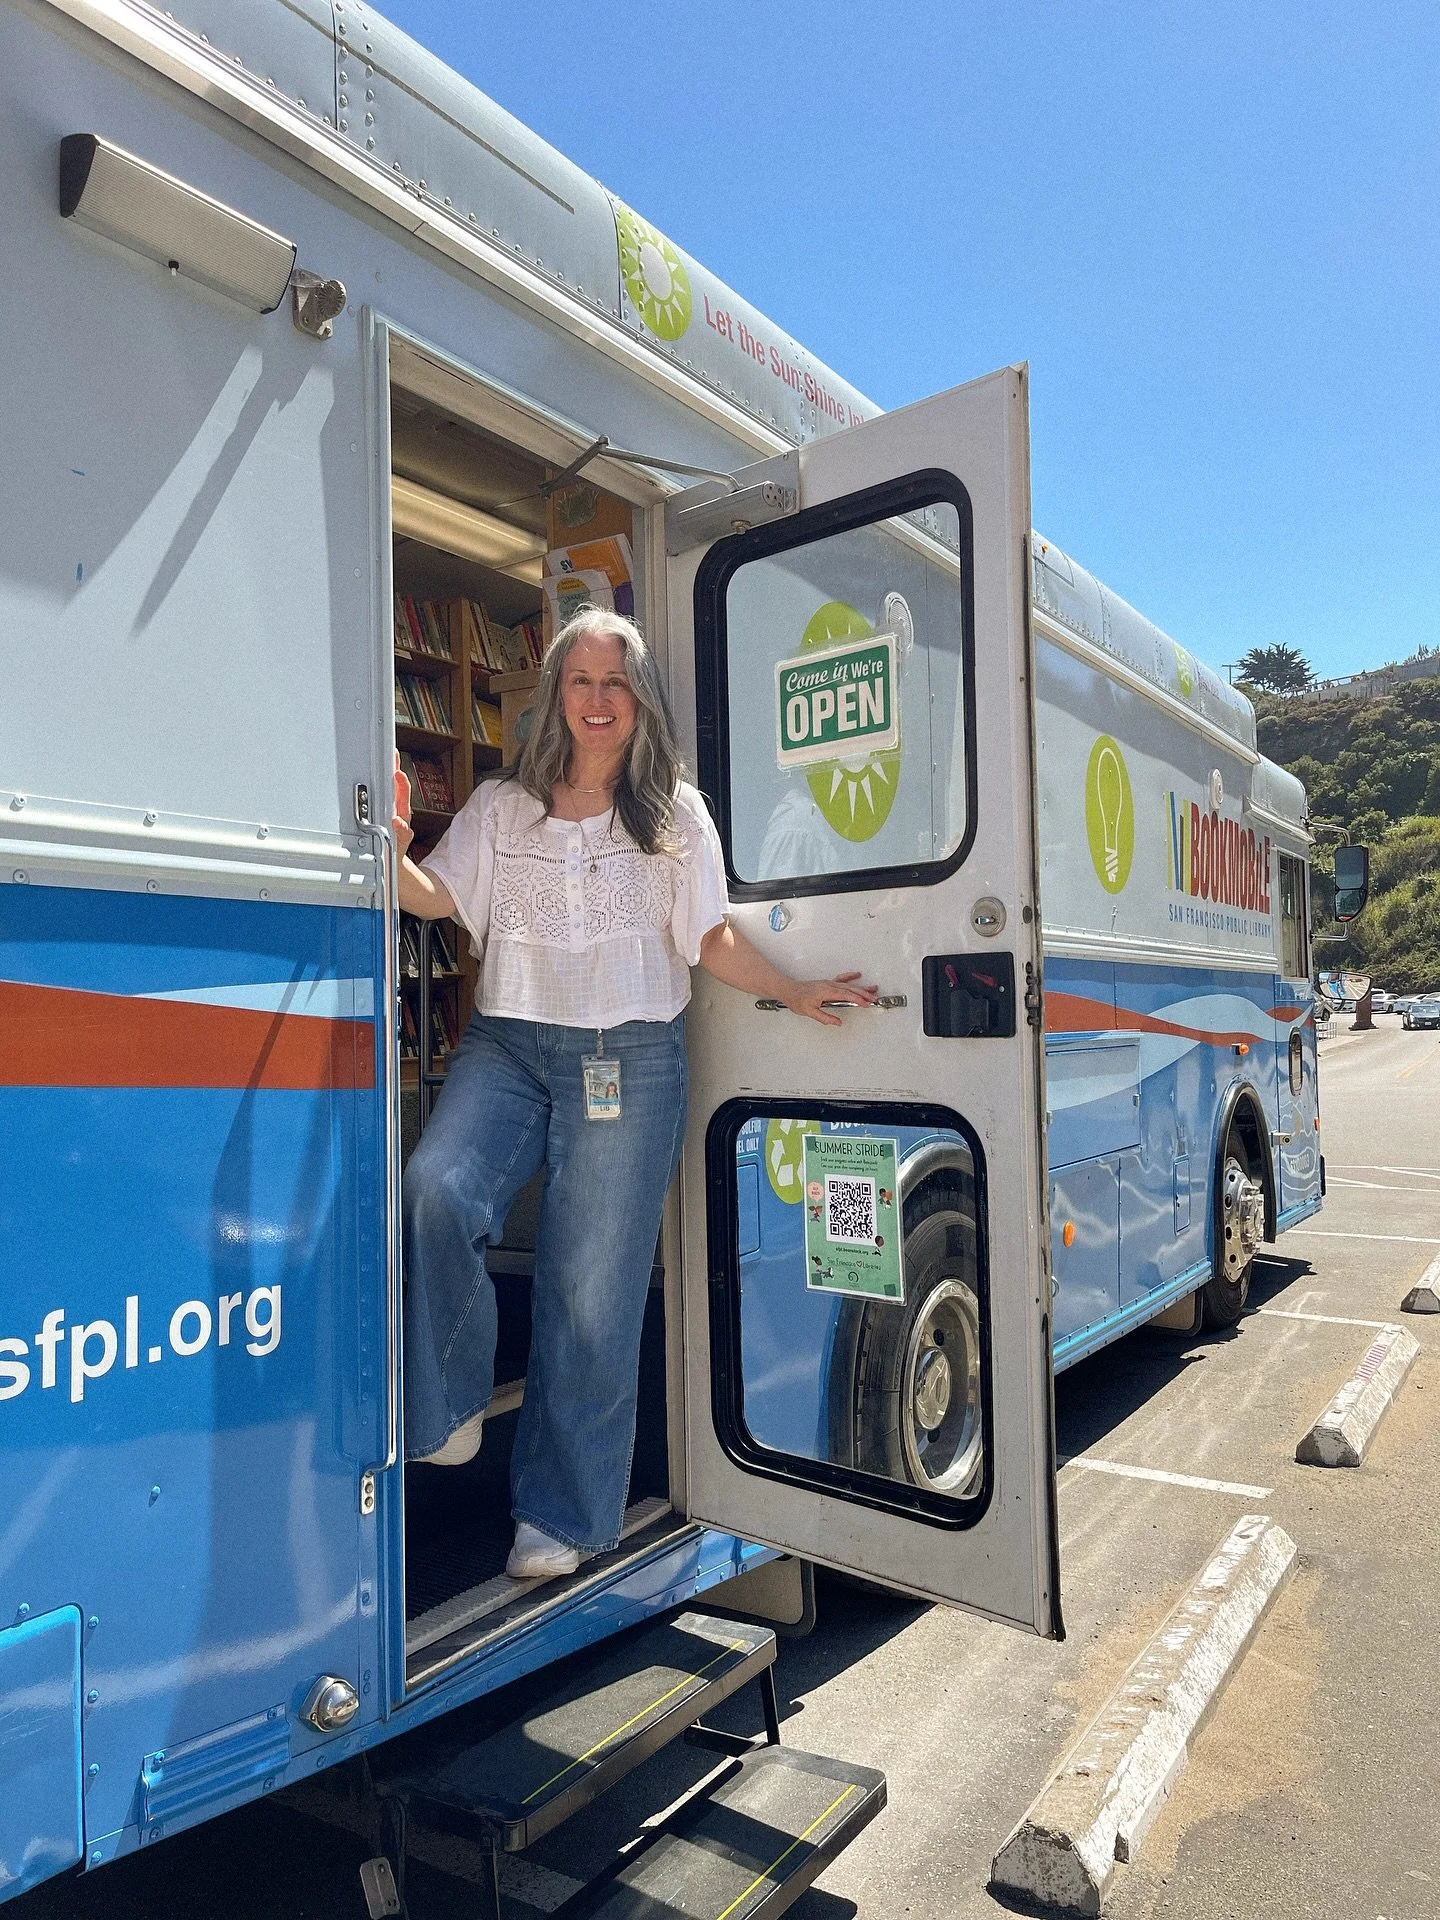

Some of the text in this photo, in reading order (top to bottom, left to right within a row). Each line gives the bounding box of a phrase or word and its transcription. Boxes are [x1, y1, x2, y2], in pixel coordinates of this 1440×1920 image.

[703, 293, 864, 427] Let the Sun Shine In
[785, 660, 883, 693] Come in We're
[785, 677, 884, 742] OPEN
[1168, 903, 1271, 938] SAN FRANCISCO PUBLIC LIBRARY
[746, 1136, 760, 1152] ONLY
[814, 1141, 885, 1157] SUMMER STRIDE
[0, 1284, 282, 1404] sfpl.org
